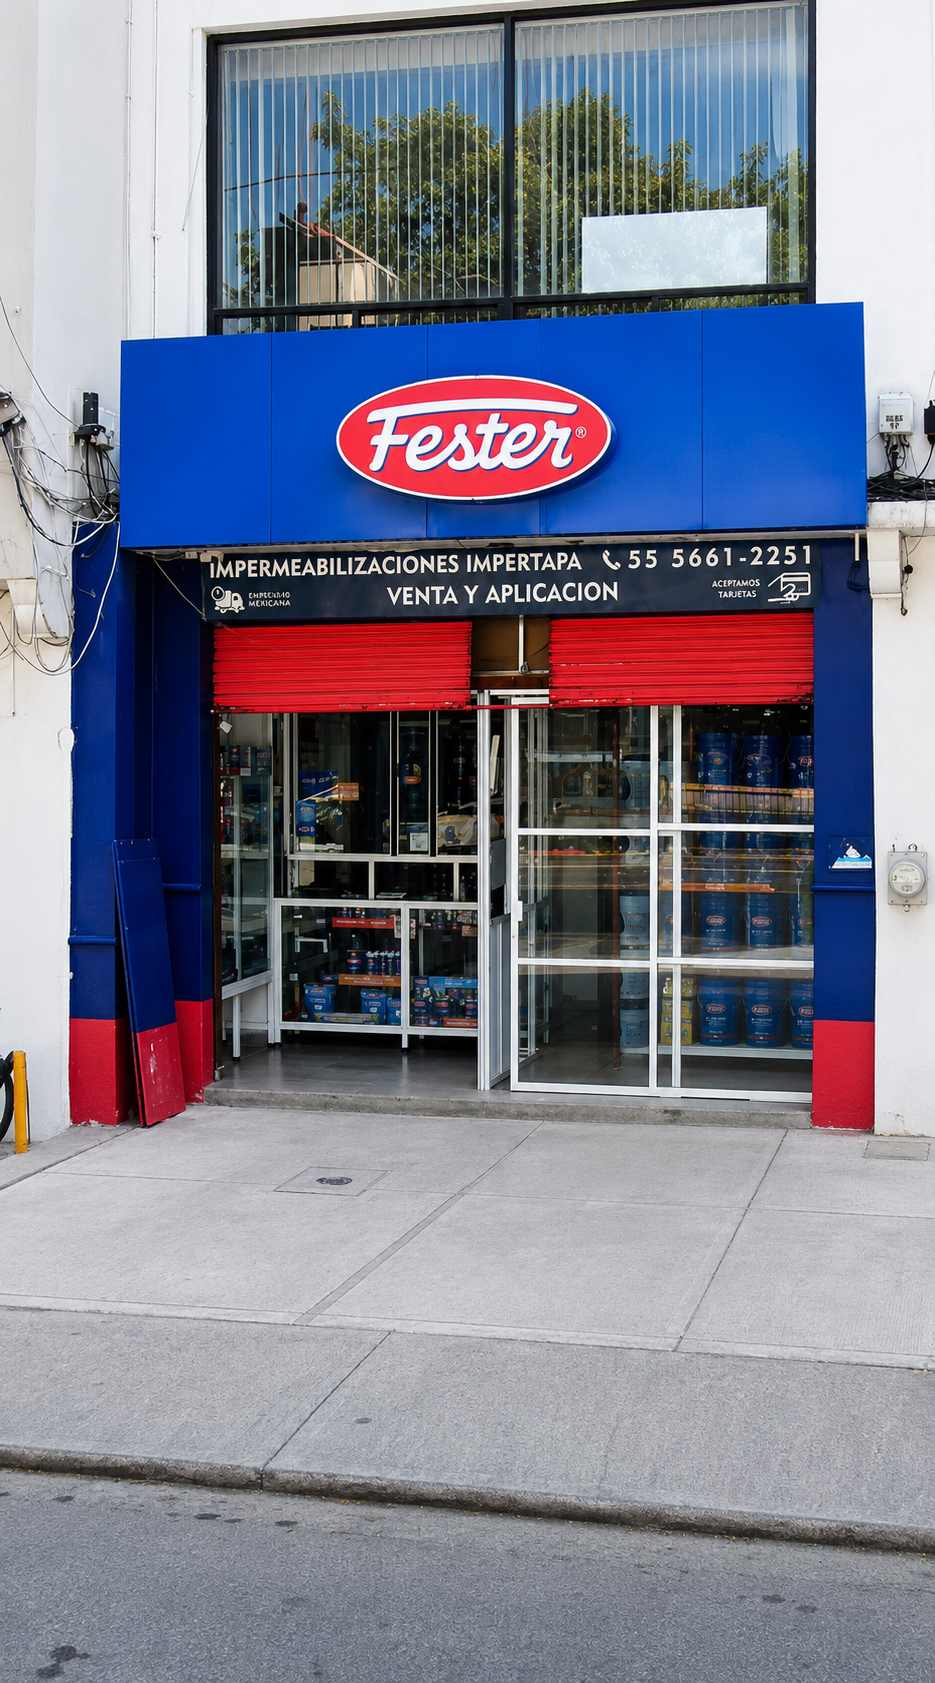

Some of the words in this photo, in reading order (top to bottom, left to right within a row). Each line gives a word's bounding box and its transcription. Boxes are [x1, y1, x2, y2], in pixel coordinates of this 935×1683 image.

[209, 554, 459, 578] IMPERMEABILIZACIONES
[466, 551, 583, 573] IMPERTAPA
[628, 549, 658, 569] 55
[671, 545, 811, 567] 5661-2251
[711, 578, 761, 588] ACEPTAMOS
[386, 585, 457, 605] VENTA
[462, 584, 480, 604] Y
[484, 581, 619, 604] APLICACION
[717, 589, 757, 599] TARJETAS
